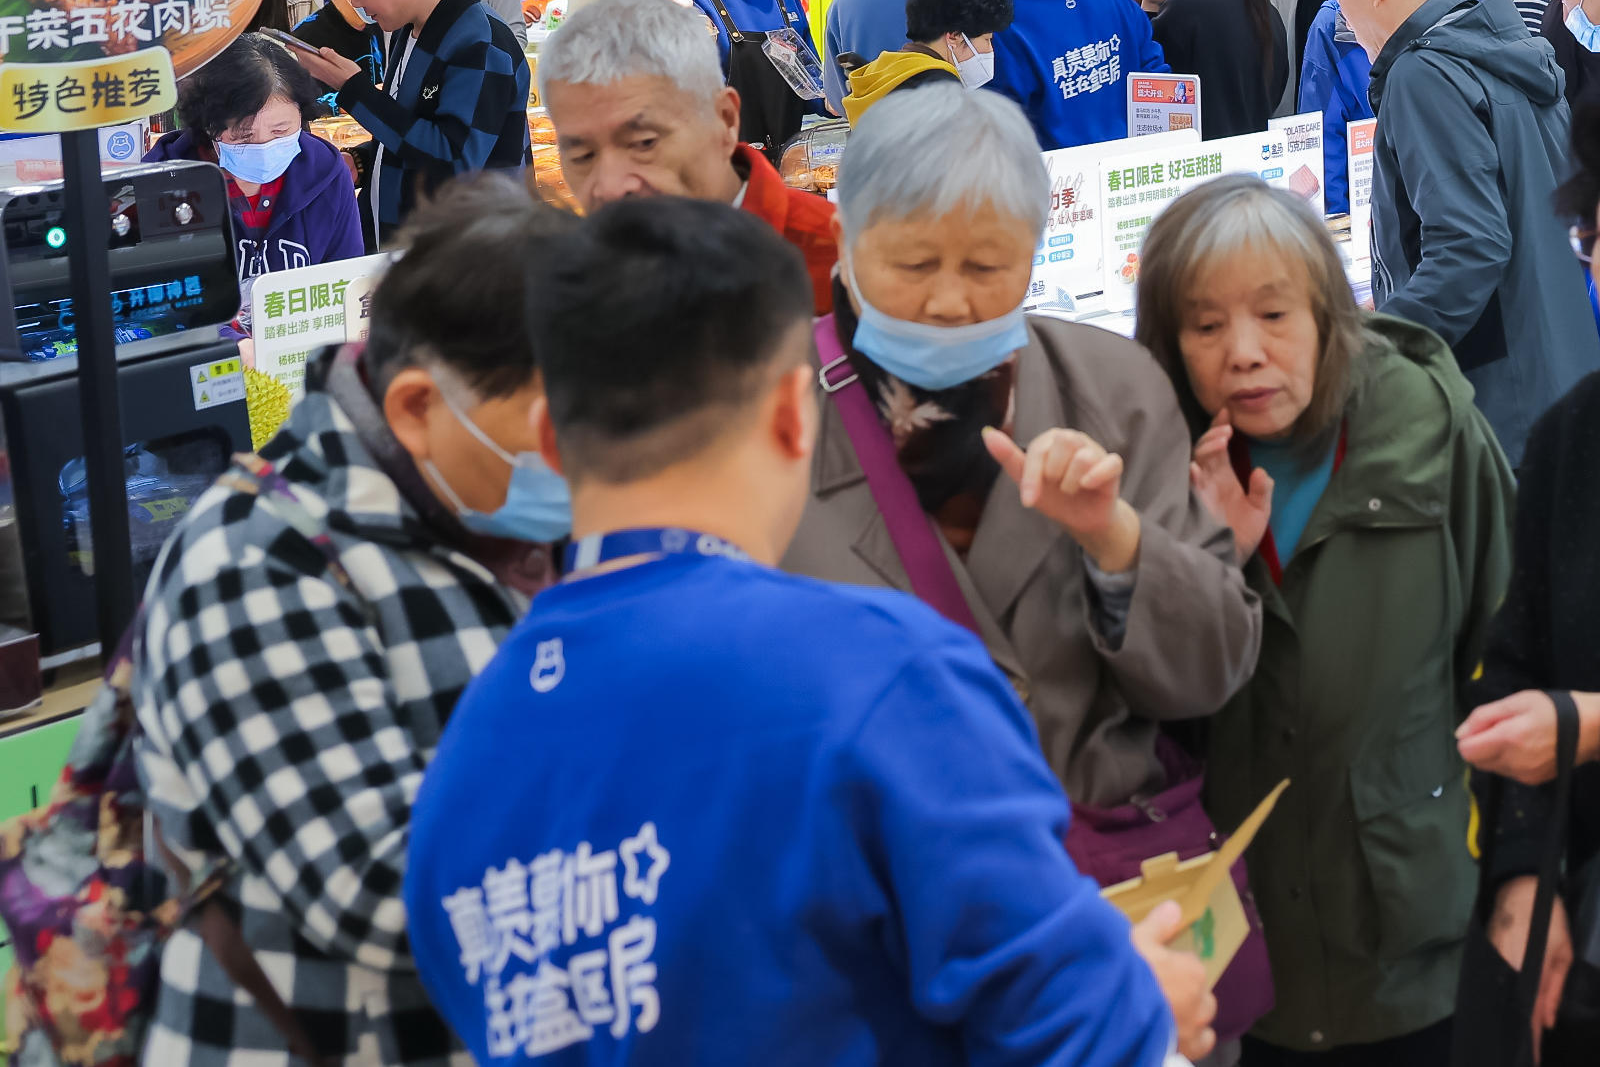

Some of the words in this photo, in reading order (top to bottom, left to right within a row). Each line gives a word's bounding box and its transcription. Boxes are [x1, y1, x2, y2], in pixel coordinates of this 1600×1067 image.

[1052, 40, 1111, 83] 真羡慕你
[1059, 55, 1121, 100] 住在盒区房
[13, 68, 161, 120] 特色推荐
[1137, 88, 1164, 98] 盛大开业
[1271, 143, 1283, 155] 盒马
[1108, 163, 1164, 192] 春日限定
[1168, 153, 1222, 181] 好运甜甜
[1108, 193, 1137, 208] 踏春出游
[1058, 209, 1093, 225] 让人更温暖
[264, 278, 351, 319] 春日限定
[264, 319, 309, 340] 踏春出游
[278, 349, 313, 366] 杨枝甘
